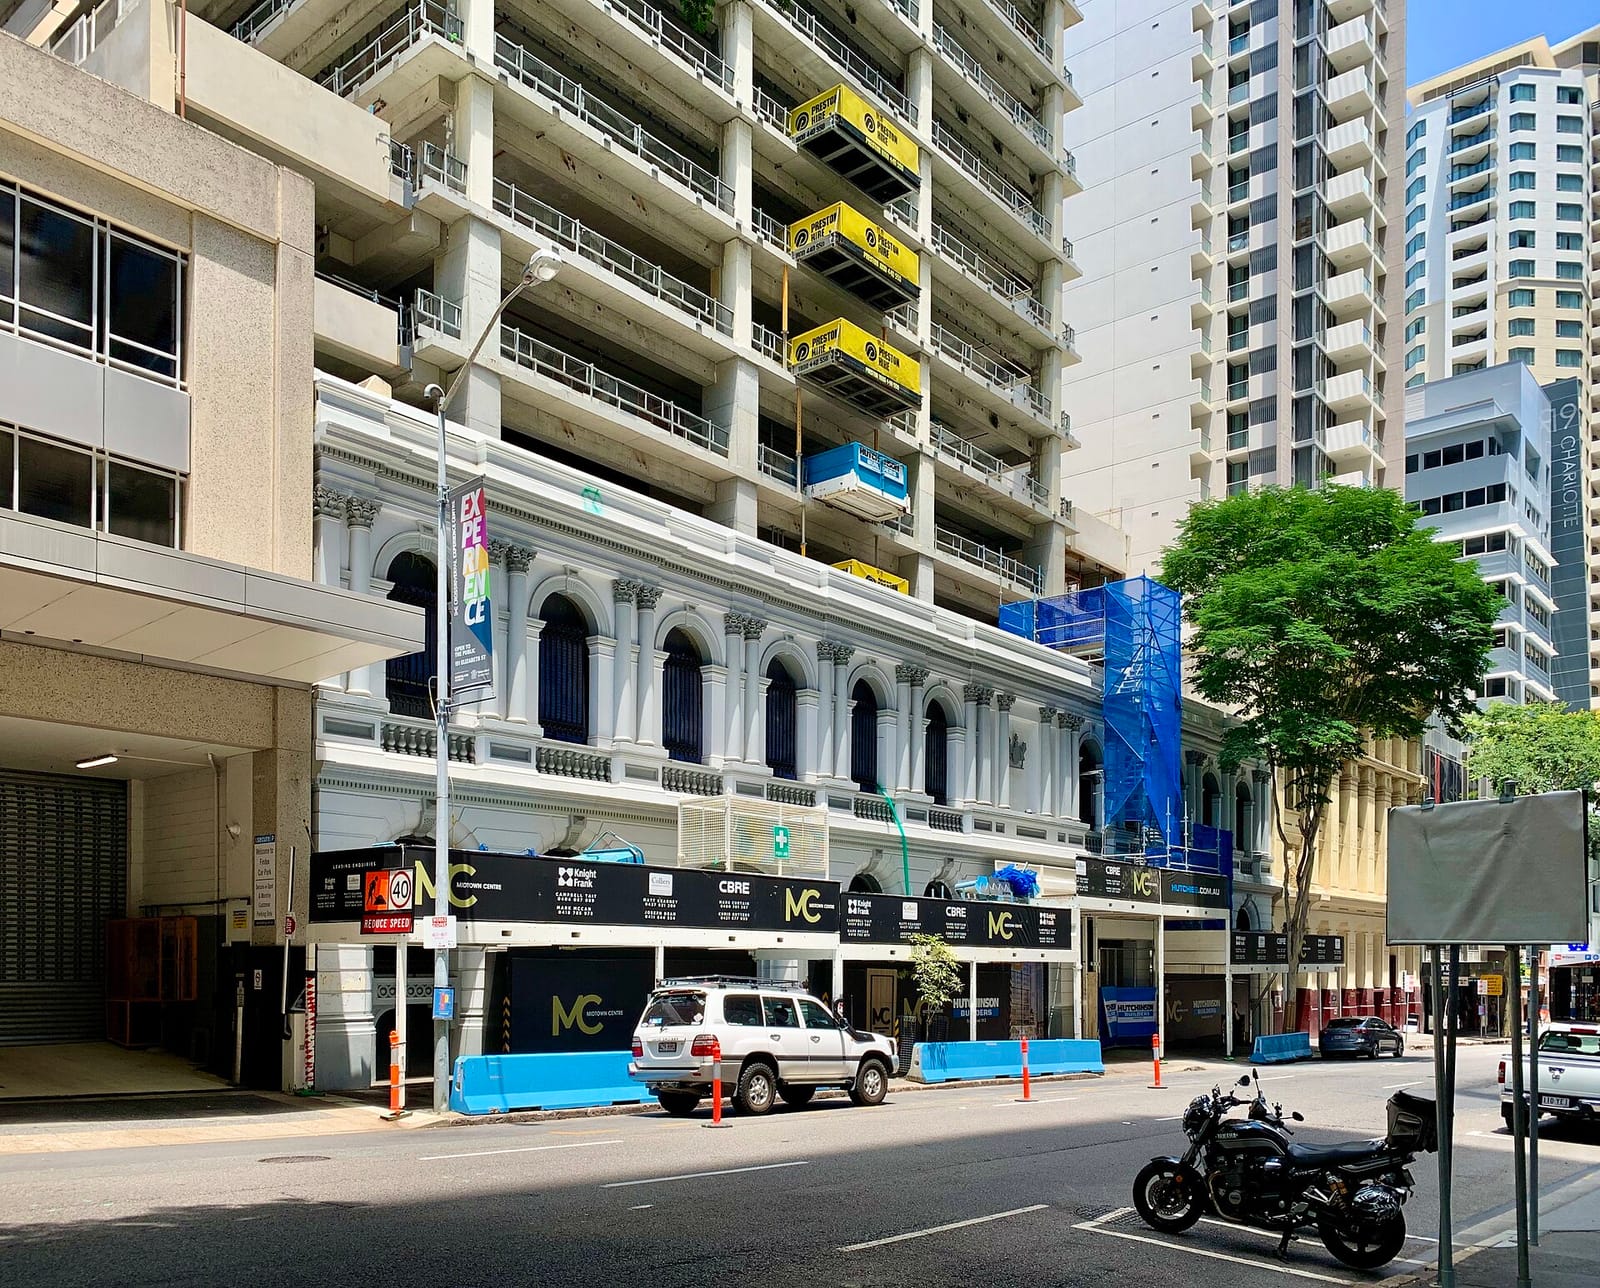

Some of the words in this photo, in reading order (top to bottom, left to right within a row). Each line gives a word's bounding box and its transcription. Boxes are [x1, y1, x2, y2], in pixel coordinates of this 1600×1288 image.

[574, 868, 597, 880] Knight
[1105, 865, 1121, 876] CBRE
[393, 880, 408, 899] 40
[574, 878, 593, 888] Frank
[719, 880, 750, 895] CBRE
[1133, 870, 1152, 897] MC
[785, 887, 821, 923] MC
[945, 906, 967, 918] CBRE
[363, 919, 387, 929] REDUCE
[389, 917, 410, 928] SPEED
[988, 911, 1013, 940] MC
[551, 993, 604, 1036] MC
[872, 1006, 891, 1026] MC
